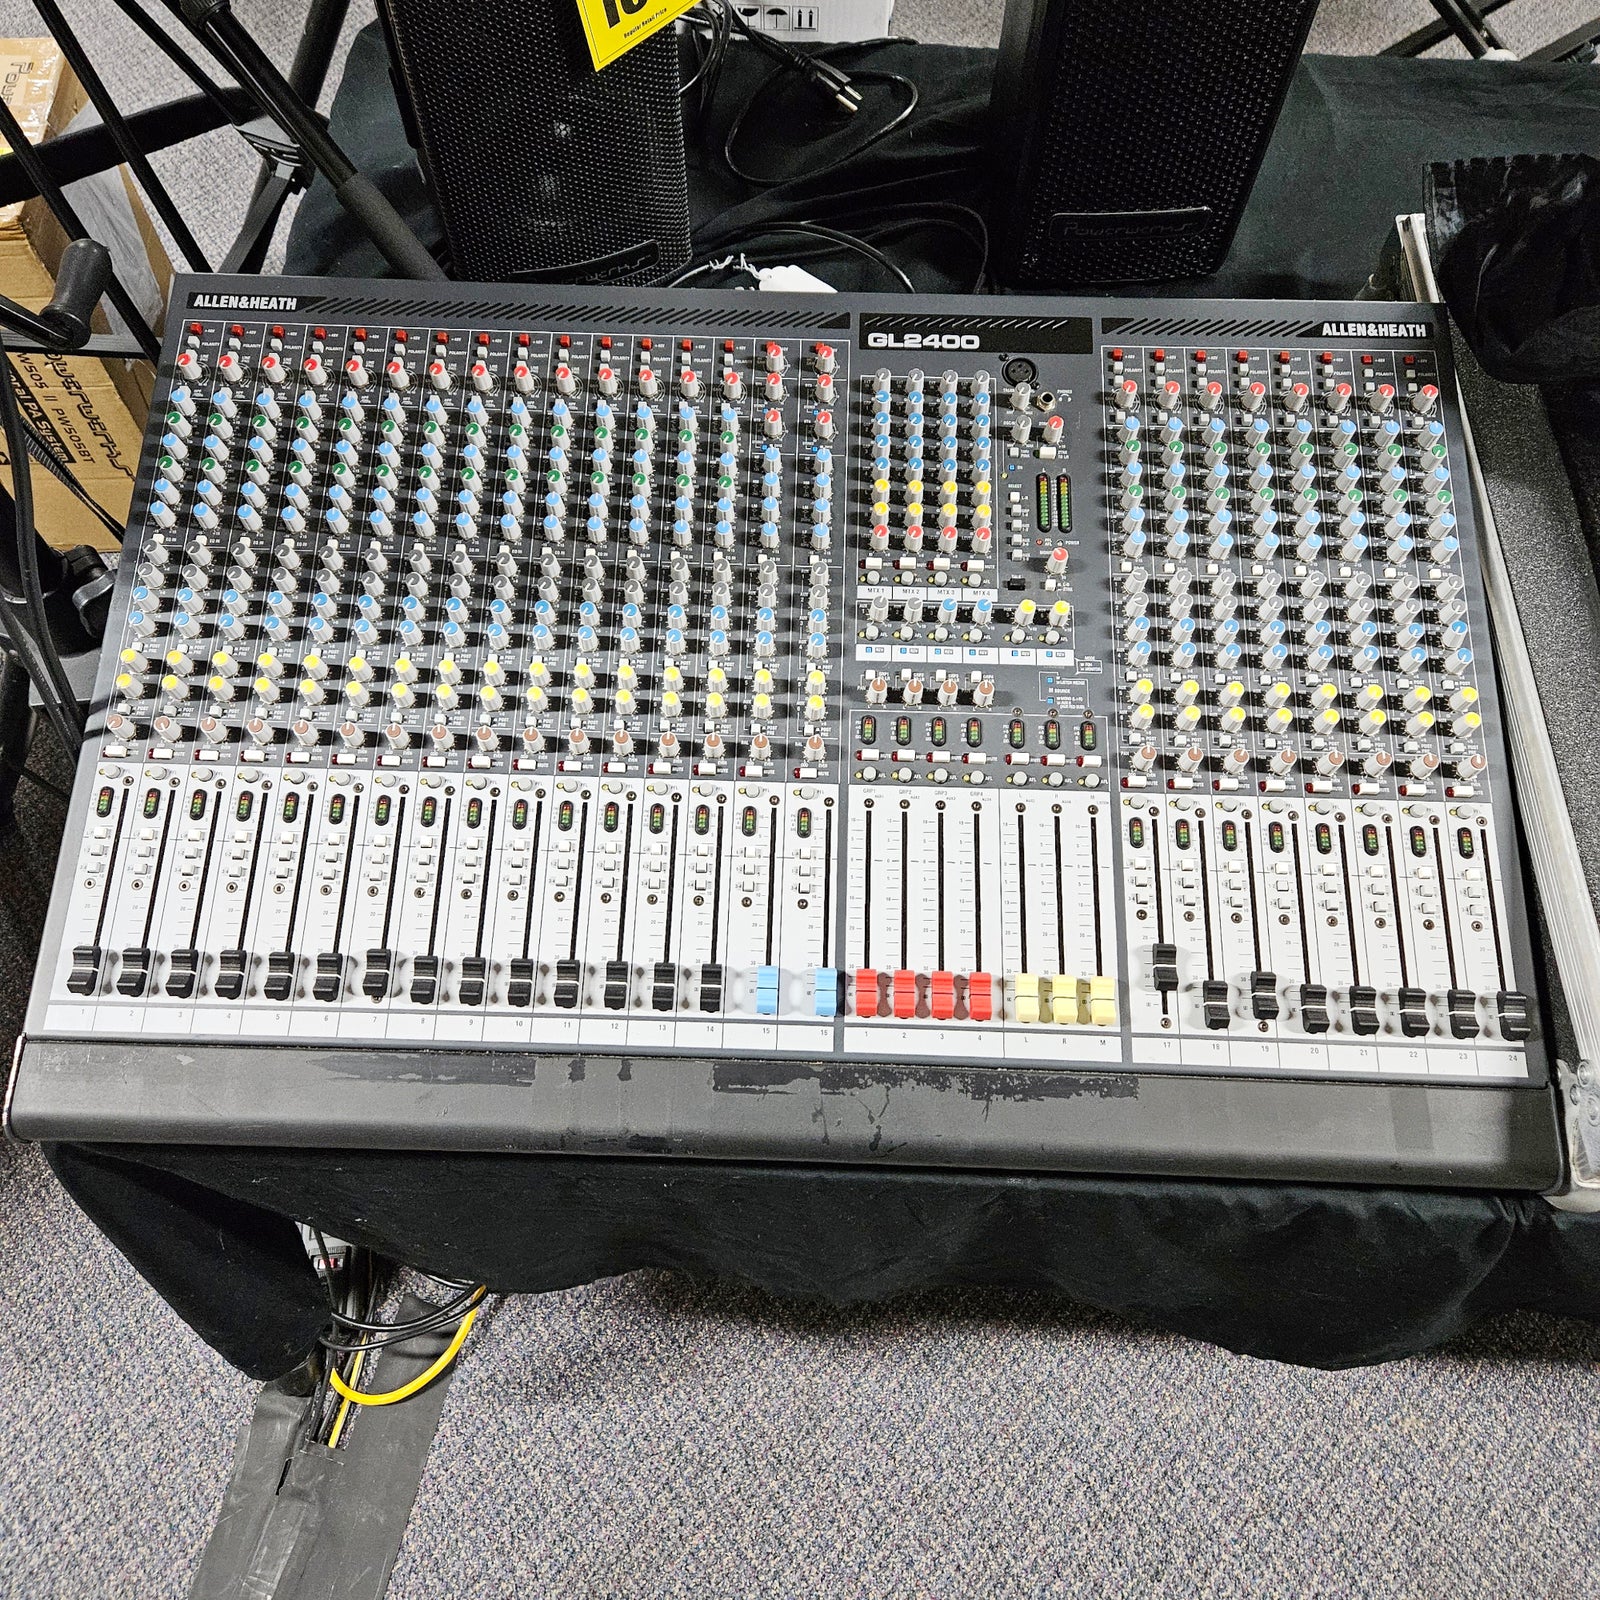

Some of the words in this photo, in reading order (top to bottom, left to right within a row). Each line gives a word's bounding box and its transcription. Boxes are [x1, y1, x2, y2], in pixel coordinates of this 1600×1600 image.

[194, 294, 297, 310] ALLEN&HEATH
[867, 332, 980, 349] GL2400
[1322, 322, 1427, 337] ALLEN&HEATH
[17, 353, 49, 389] W505
[52, 408, 95, 463] PW505BT
[45, 354, 136, 481] owerwerks
[24, 401, 42, 418] PA
[36, 421, 69, 462] System
